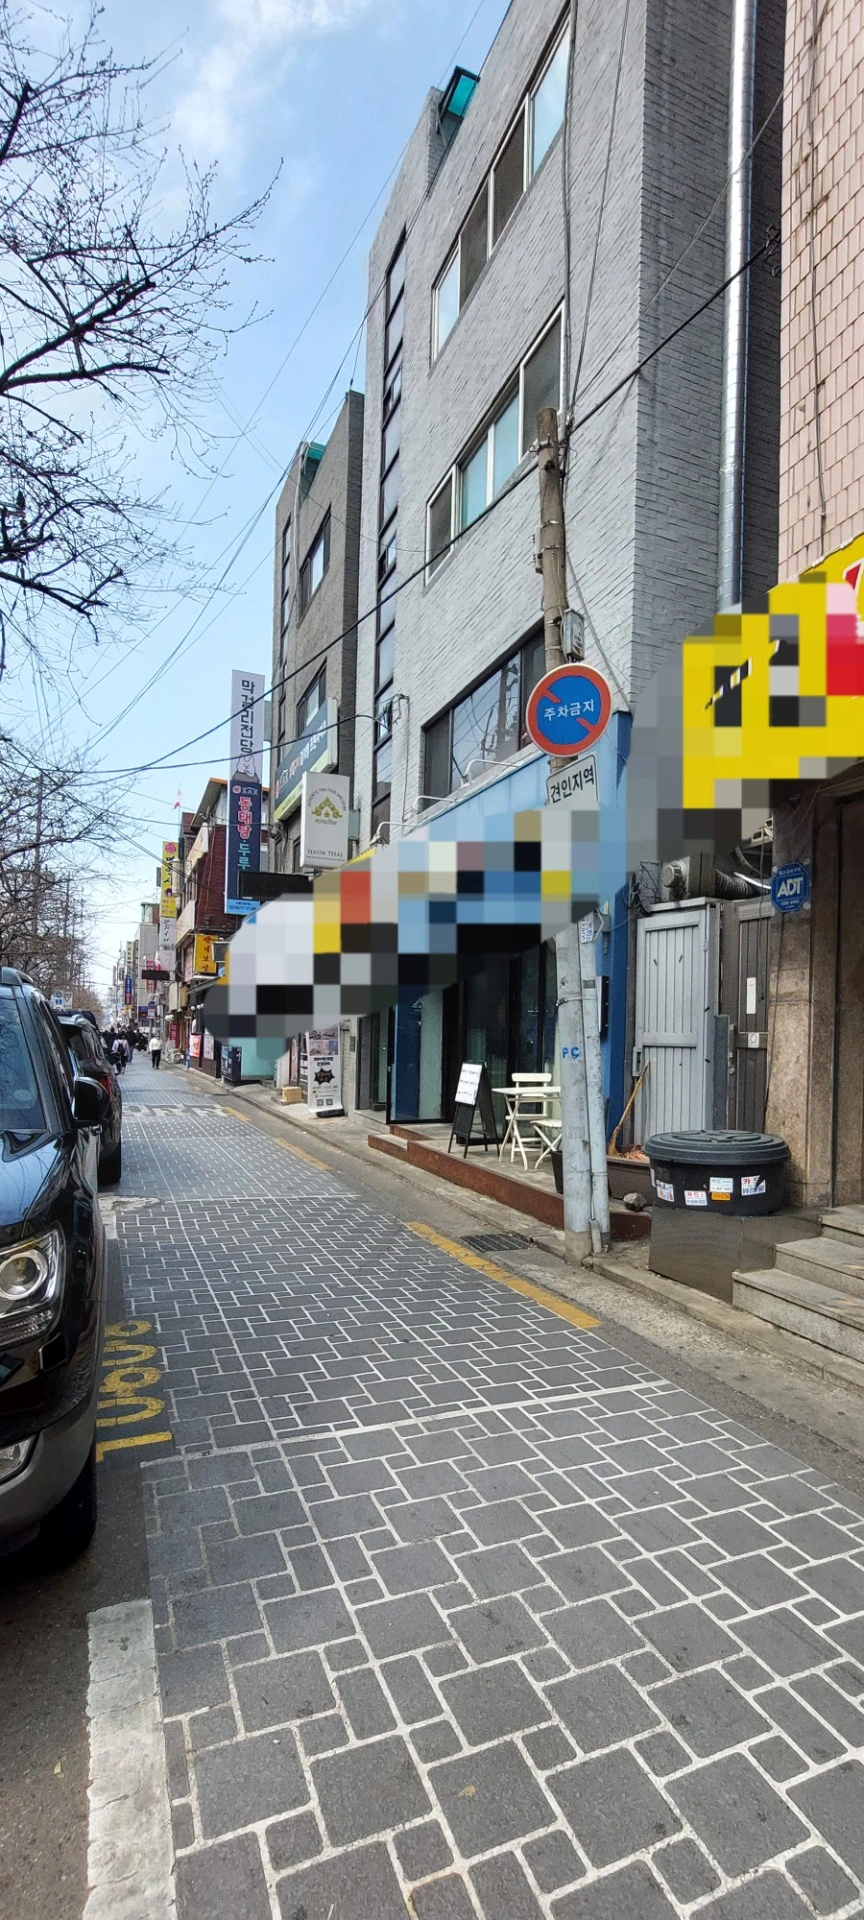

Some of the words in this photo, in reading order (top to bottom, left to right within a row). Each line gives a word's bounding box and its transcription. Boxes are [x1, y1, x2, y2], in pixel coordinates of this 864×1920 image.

[240, 679, 255, 754] 막걸리전당
[543, 699, 594, 721] 주차금지
[550, 765, 595, 804] 견인지역
[307, 848, 326, 856] HAUN
[328, 850, 343, 858] THAI
[776, 877, 804, 898] ADT
